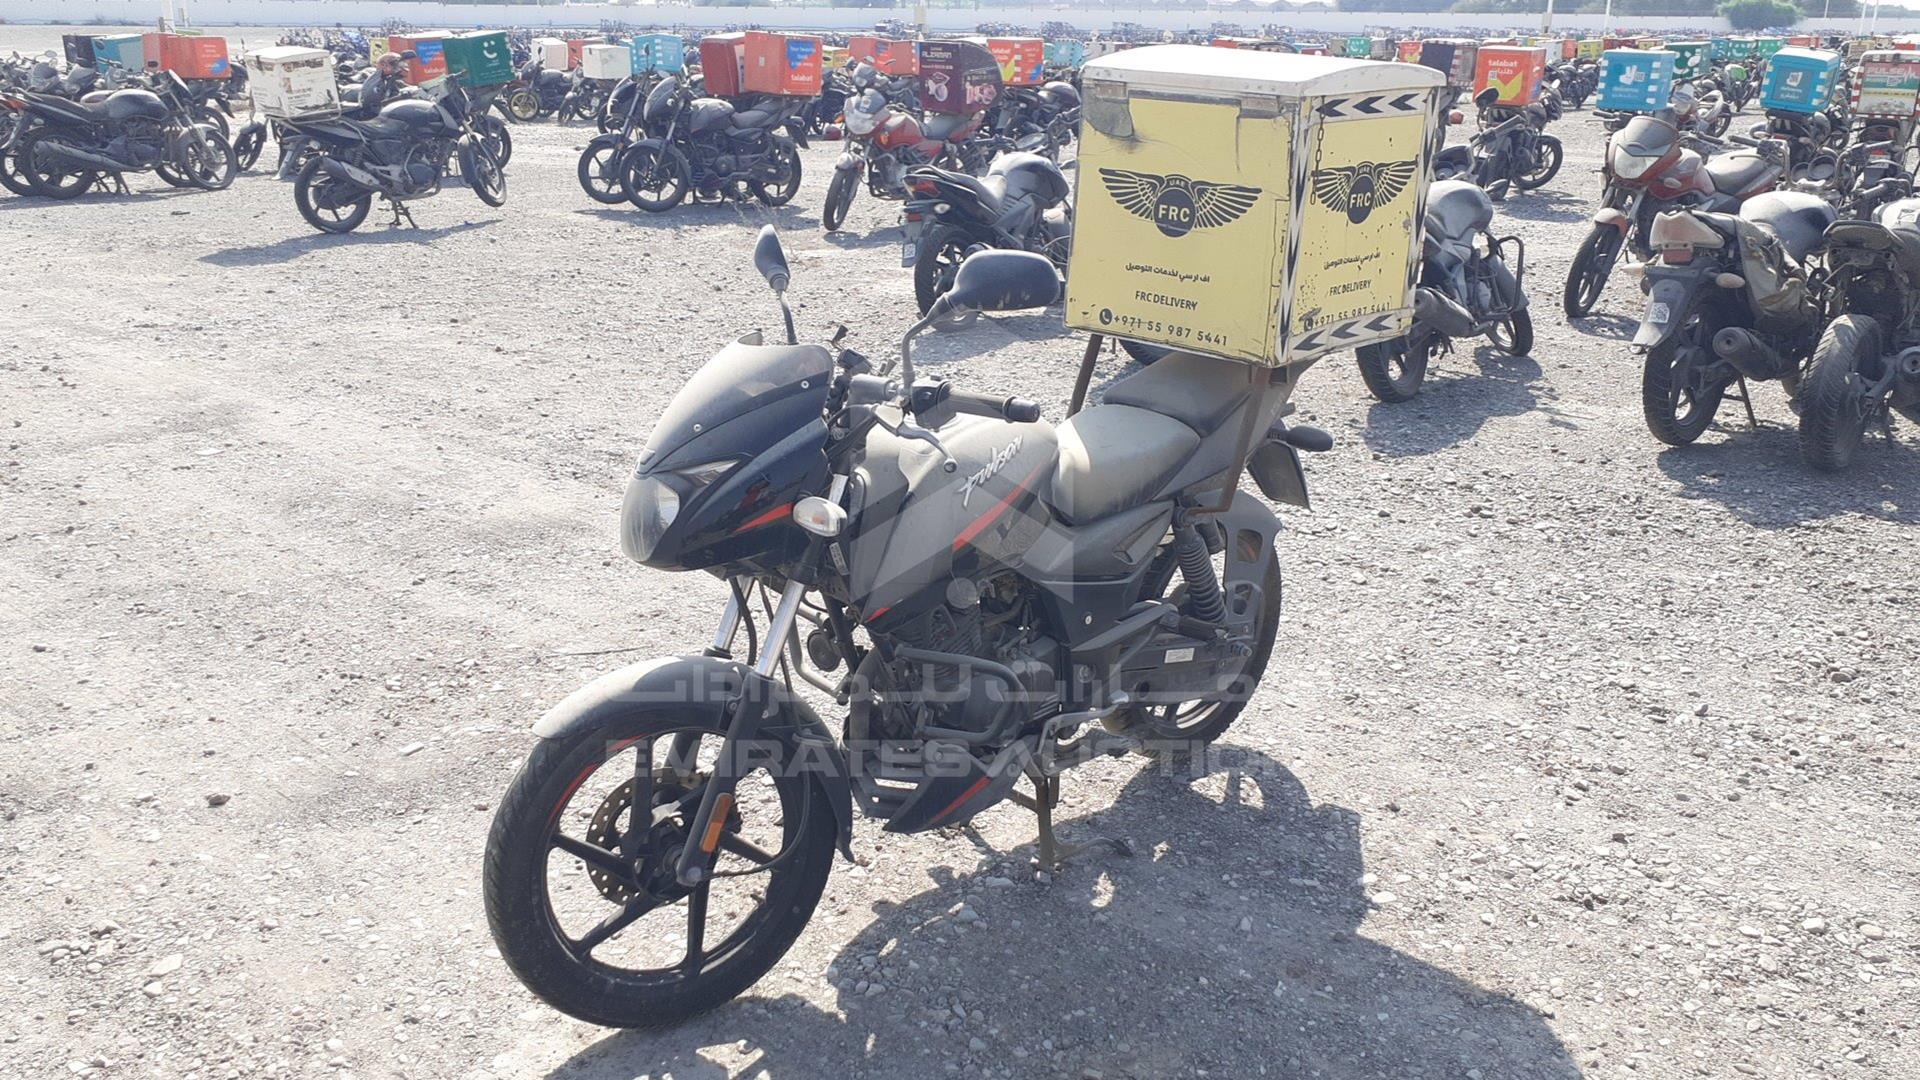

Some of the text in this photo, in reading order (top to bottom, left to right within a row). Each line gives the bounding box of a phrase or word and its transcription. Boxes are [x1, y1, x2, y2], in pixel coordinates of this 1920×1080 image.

[1488, 59, 1518, 67] talabat
[1169, 179, 1185, 188] UAE
[1350, 192, 1371, 208] FRC
[1158, 204, 1190, 223] FRC
[1125, 262, 1153, 273] التوصيل
[1329, 279, 1372, 296] FRC DELIVERY
[1135, 290, 1198, 311] FRC DELIVERY
[1114, 315, 1227, 346] +971 55 987 5441
